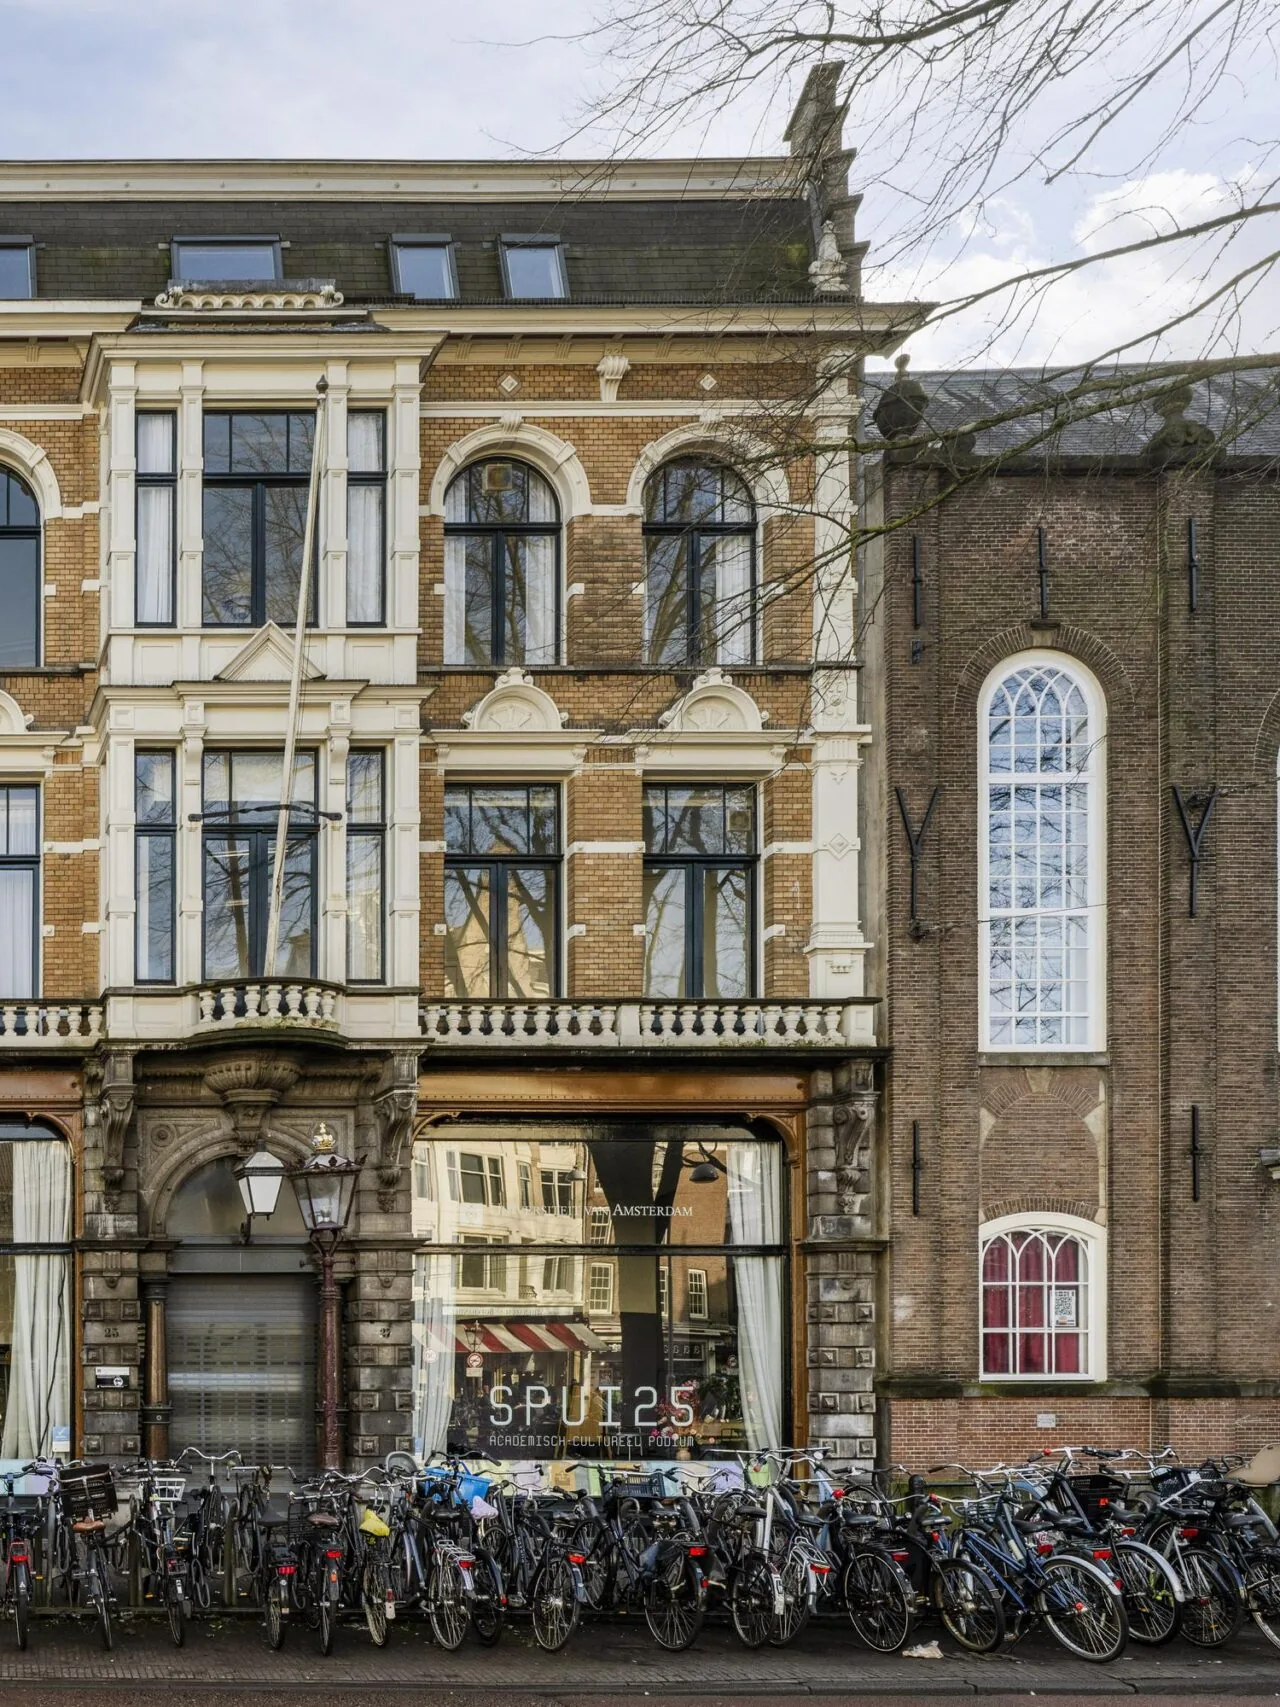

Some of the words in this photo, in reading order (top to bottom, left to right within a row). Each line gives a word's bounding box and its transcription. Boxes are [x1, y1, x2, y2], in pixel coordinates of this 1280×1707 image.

[612, 1203, 693, 1216] AMSTERDAM
[104, 1327, 119, 1338] 25
[489, 1386, 694, 1426] SPUI25
[648, 1435, 694, 1447] PODIUM
